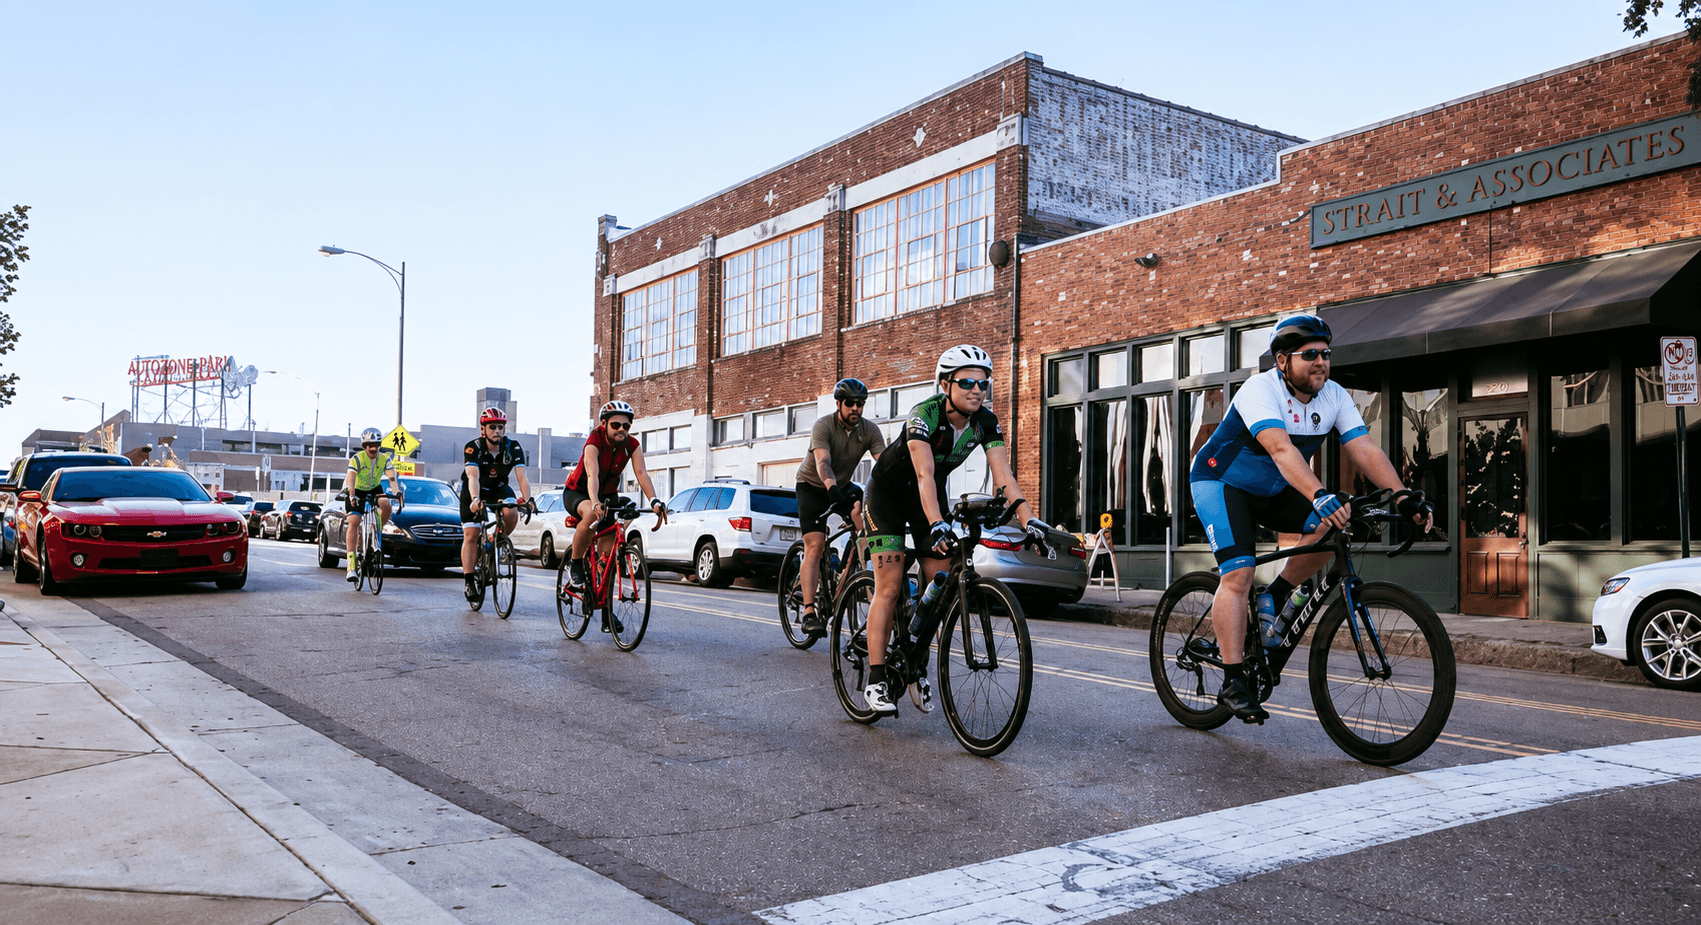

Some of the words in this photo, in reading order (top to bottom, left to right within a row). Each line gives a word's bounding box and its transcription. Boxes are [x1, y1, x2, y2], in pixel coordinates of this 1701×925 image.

[1323, 188, 1426, 235] STRAIT
[1436, 183, 1458, 209] &
[1467, 125, 1685, 203] ASSOCIATES
[127, 358, 195, 376] AUTOZONE
